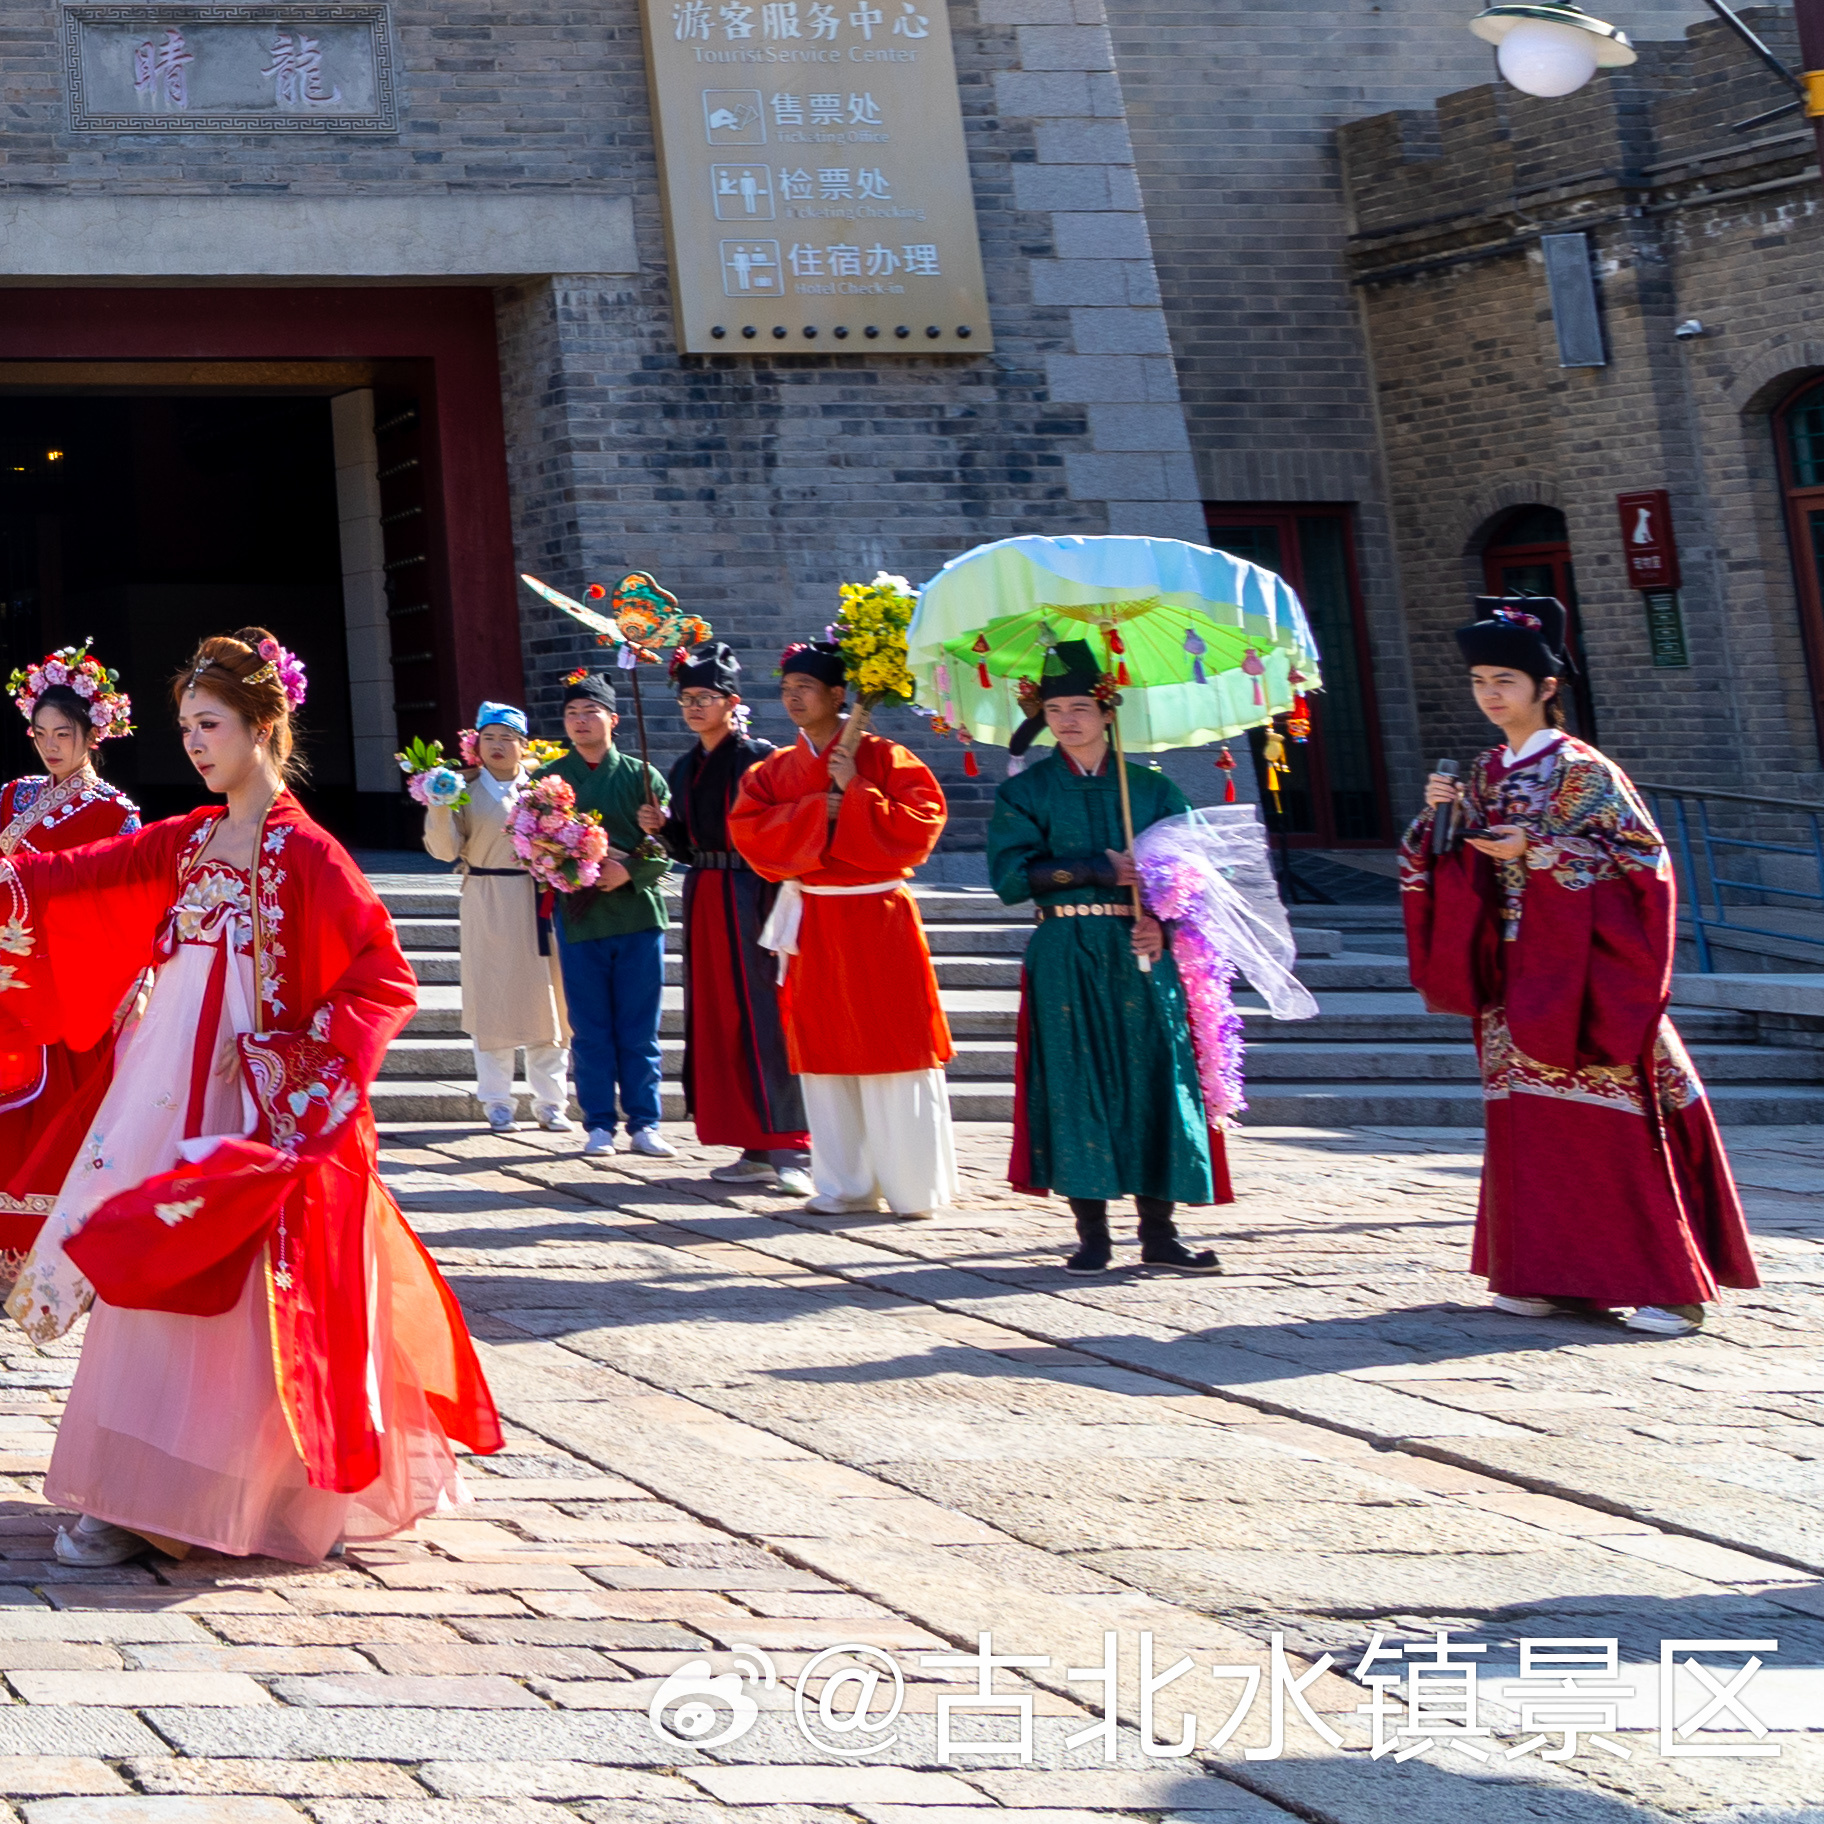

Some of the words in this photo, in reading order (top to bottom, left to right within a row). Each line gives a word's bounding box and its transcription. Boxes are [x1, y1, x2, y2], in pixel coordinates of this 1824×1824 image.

[671, 0, 930, 42] 游客服务中心
[848, 47, 919, 64] Center
[769, 92, 883, 126] 售票处
[778, 167, 892, 201] 检票处
[788, 242, 942, 277] 住宿办理
